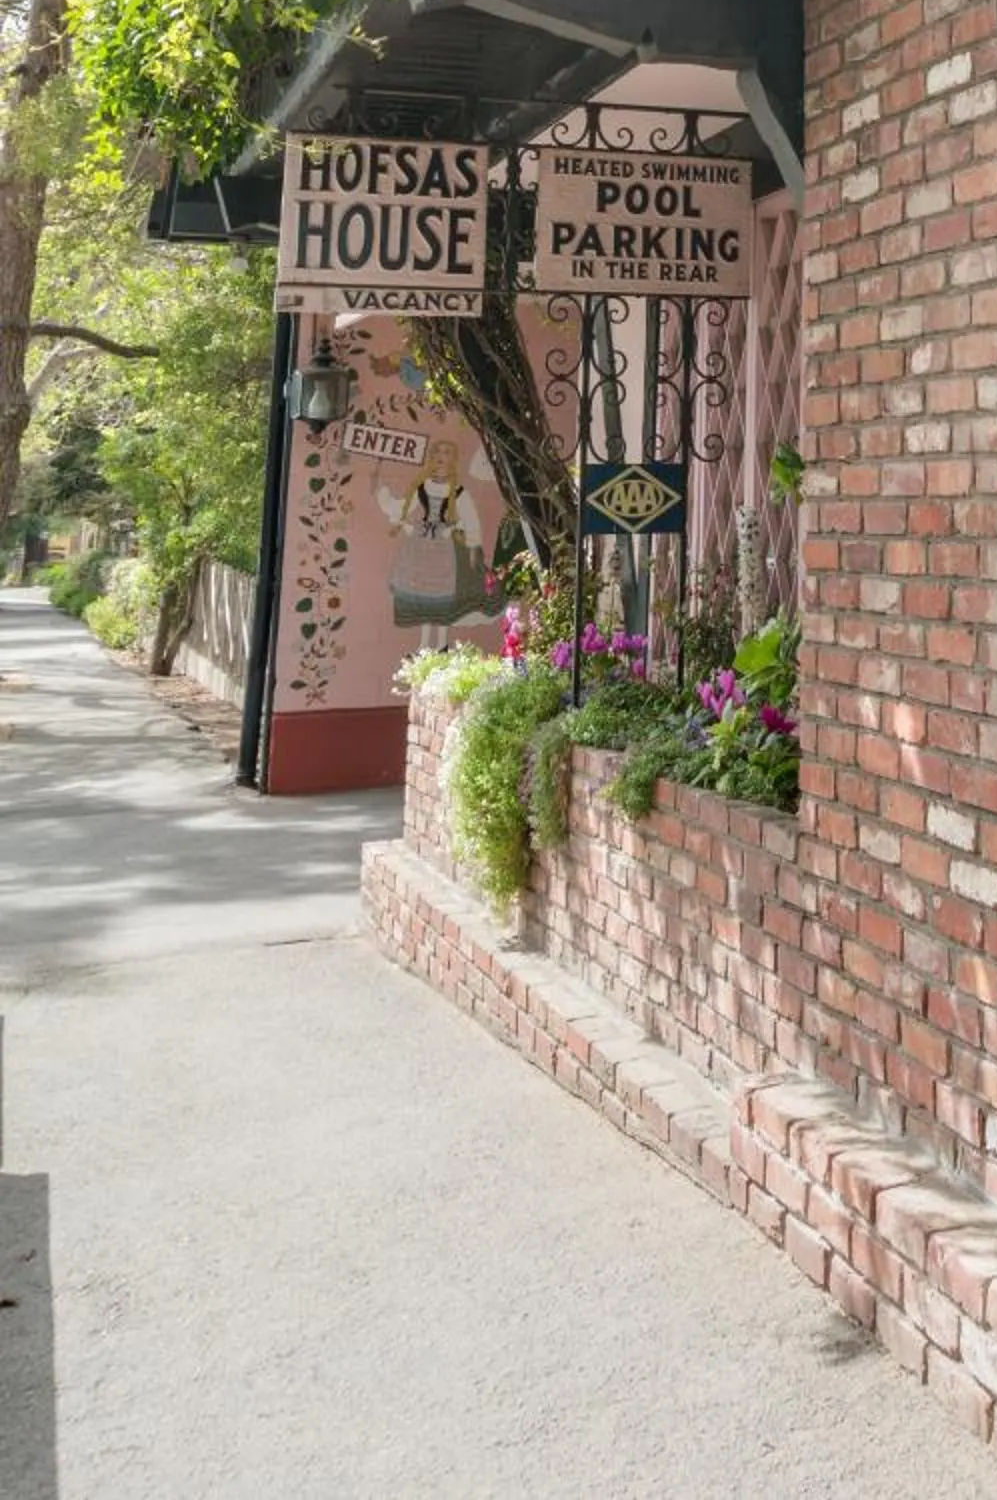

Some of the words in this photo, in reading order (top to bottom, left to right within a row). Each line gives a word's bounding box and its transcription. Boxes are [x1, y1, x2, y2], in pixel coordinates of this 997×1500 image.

[300, 140, 478, 199] HOFSAS
[554, 156, 635, 176] HEATED
[641, 163, 741, 185] SWIMMING
[595, 181, 703, 218] POOL
[296, 201, 476, 274] HOUSE
[551, 221, 741, 263] PARKING
[571, 260, 594, 279] IN
[605, 261, 650, 281] THE
[659, 264, 719, 283] REAR
[342, 289, 480, 311] VACANCY
[351, 428, 417, 459] ENTER
[606, 481, 660, 514] AAA
